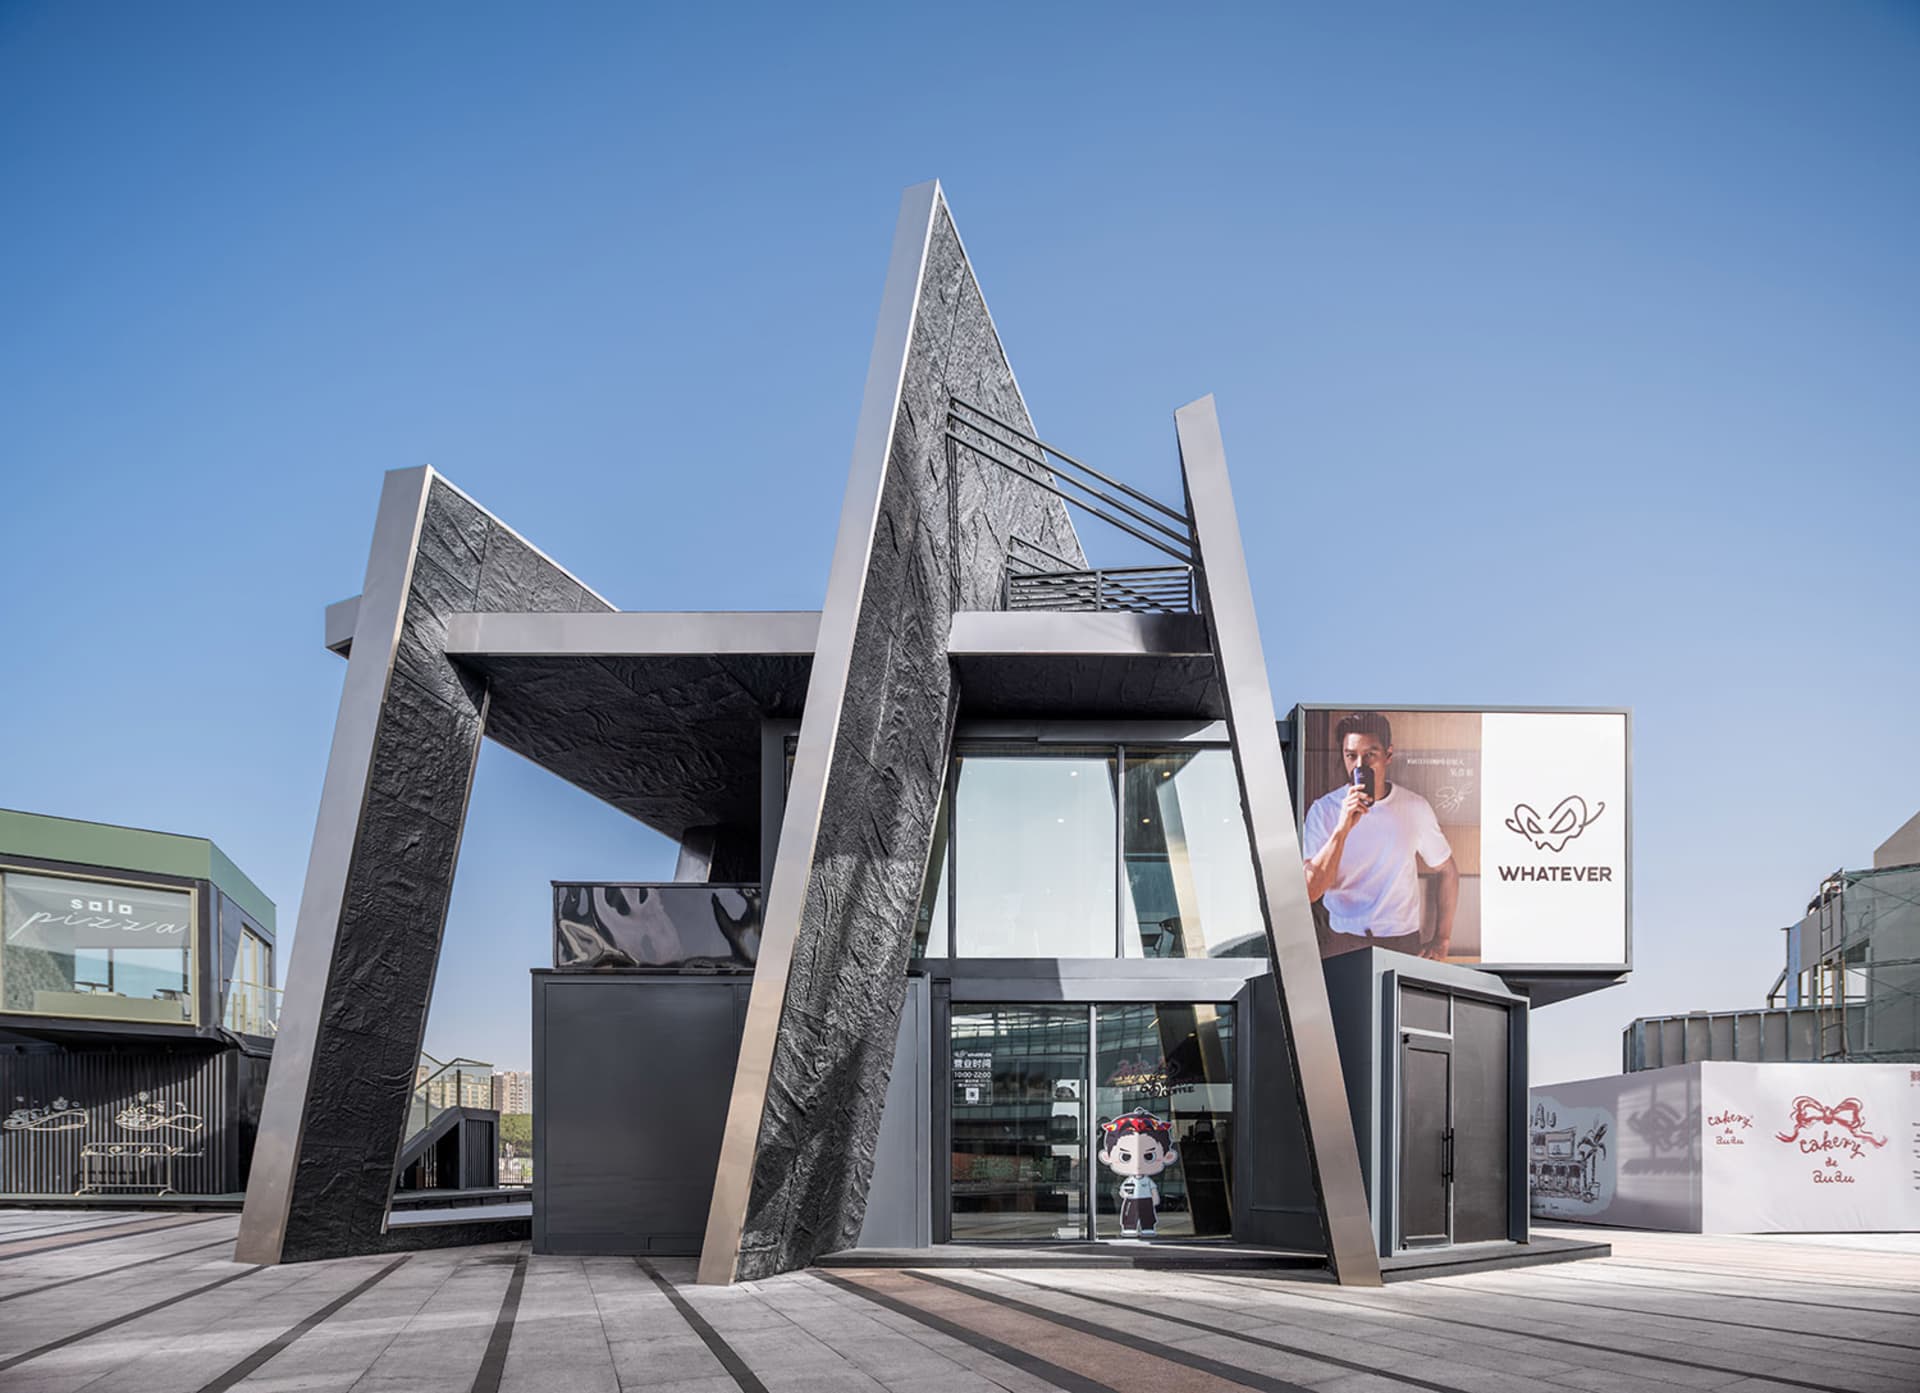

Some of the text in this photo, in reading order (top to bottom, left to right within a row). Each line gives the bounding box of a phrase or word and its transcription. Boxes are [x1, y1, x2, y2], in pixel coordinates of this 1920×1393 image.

[1498, 866, 1612, 881] WHATEVER
[8, 911, 187, 940] pizza
[953, 1058, 992, 1069] 营业时间
[1707, 1110, 1753, 1129] cakery
[1800, 1131, 1865, 1159] cakery
[1825, 1157, 1838, 1167] de
